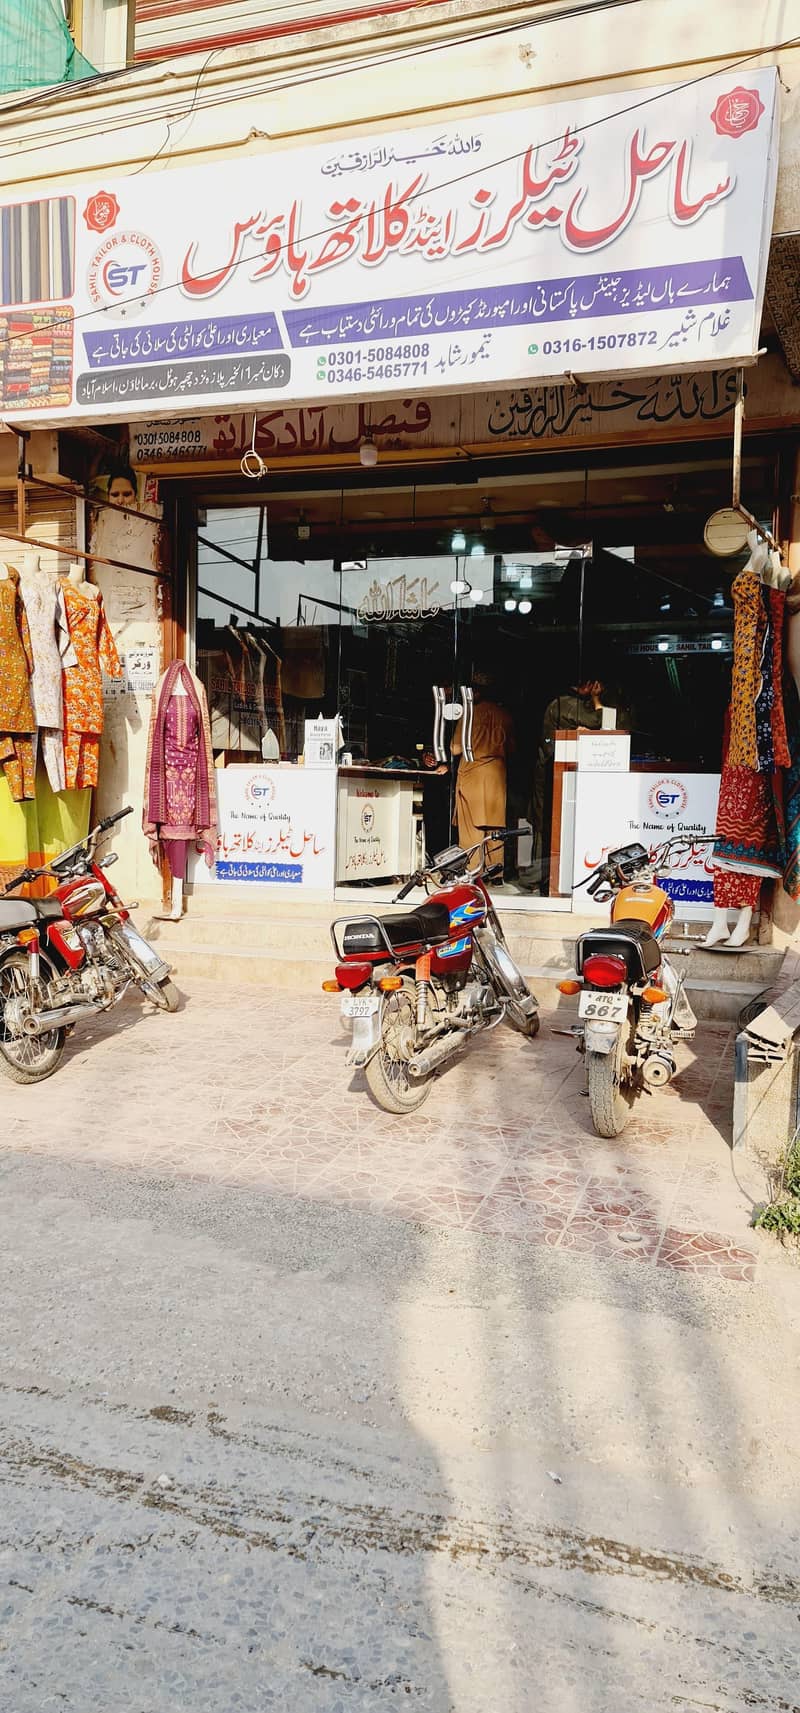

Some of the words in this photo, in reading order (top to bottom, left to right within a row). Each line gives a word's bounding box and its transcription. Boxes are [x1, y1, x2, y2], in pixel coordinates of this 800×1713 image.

[455, 125, 580, 251] ٹیلرز
[564, 128, 732, 248] ساحل
[307, 173, 423, 270] کلاتھ
[406, 207, 452, 256] اینڈ
[92, 238, 118, 268] TAILOR
[130, 234, 155, 257] CLOTH
[88, 272, 101, 302] SAHIL
[107, 264, 148, 288] ST
[676, 272, 732, 296] ہمارے
[532, 280, 577, 318] پاکستانی
[650, 276, 675, 305] ہاں
[419, 297, 436, 328] کی
[235, 326, 272, 346] معیاری
[298, 323, 321, 344] ہے
[320, 315, 363, 338] دستیاب
[697, 308, 732, 344] غلام
[327, 342, 430, 366] 0301-5084808
[542, 330, 658, 356] 0316-1507872
[91, 346, 111, 365] ہے
[326, 361, 429, 384] 0346-5465771
[253, 787, 270, 797] ST
[659, 794, 680, 804] ST
[627, 820, 640, 830] The
[643, 822, 665, 831] Name
[666, 823, 675, 833] of
[677, 822, 707, 835] Quality
[343, 932, 376, 941] HONDA
[584, 1003, 623, 1018] 867
